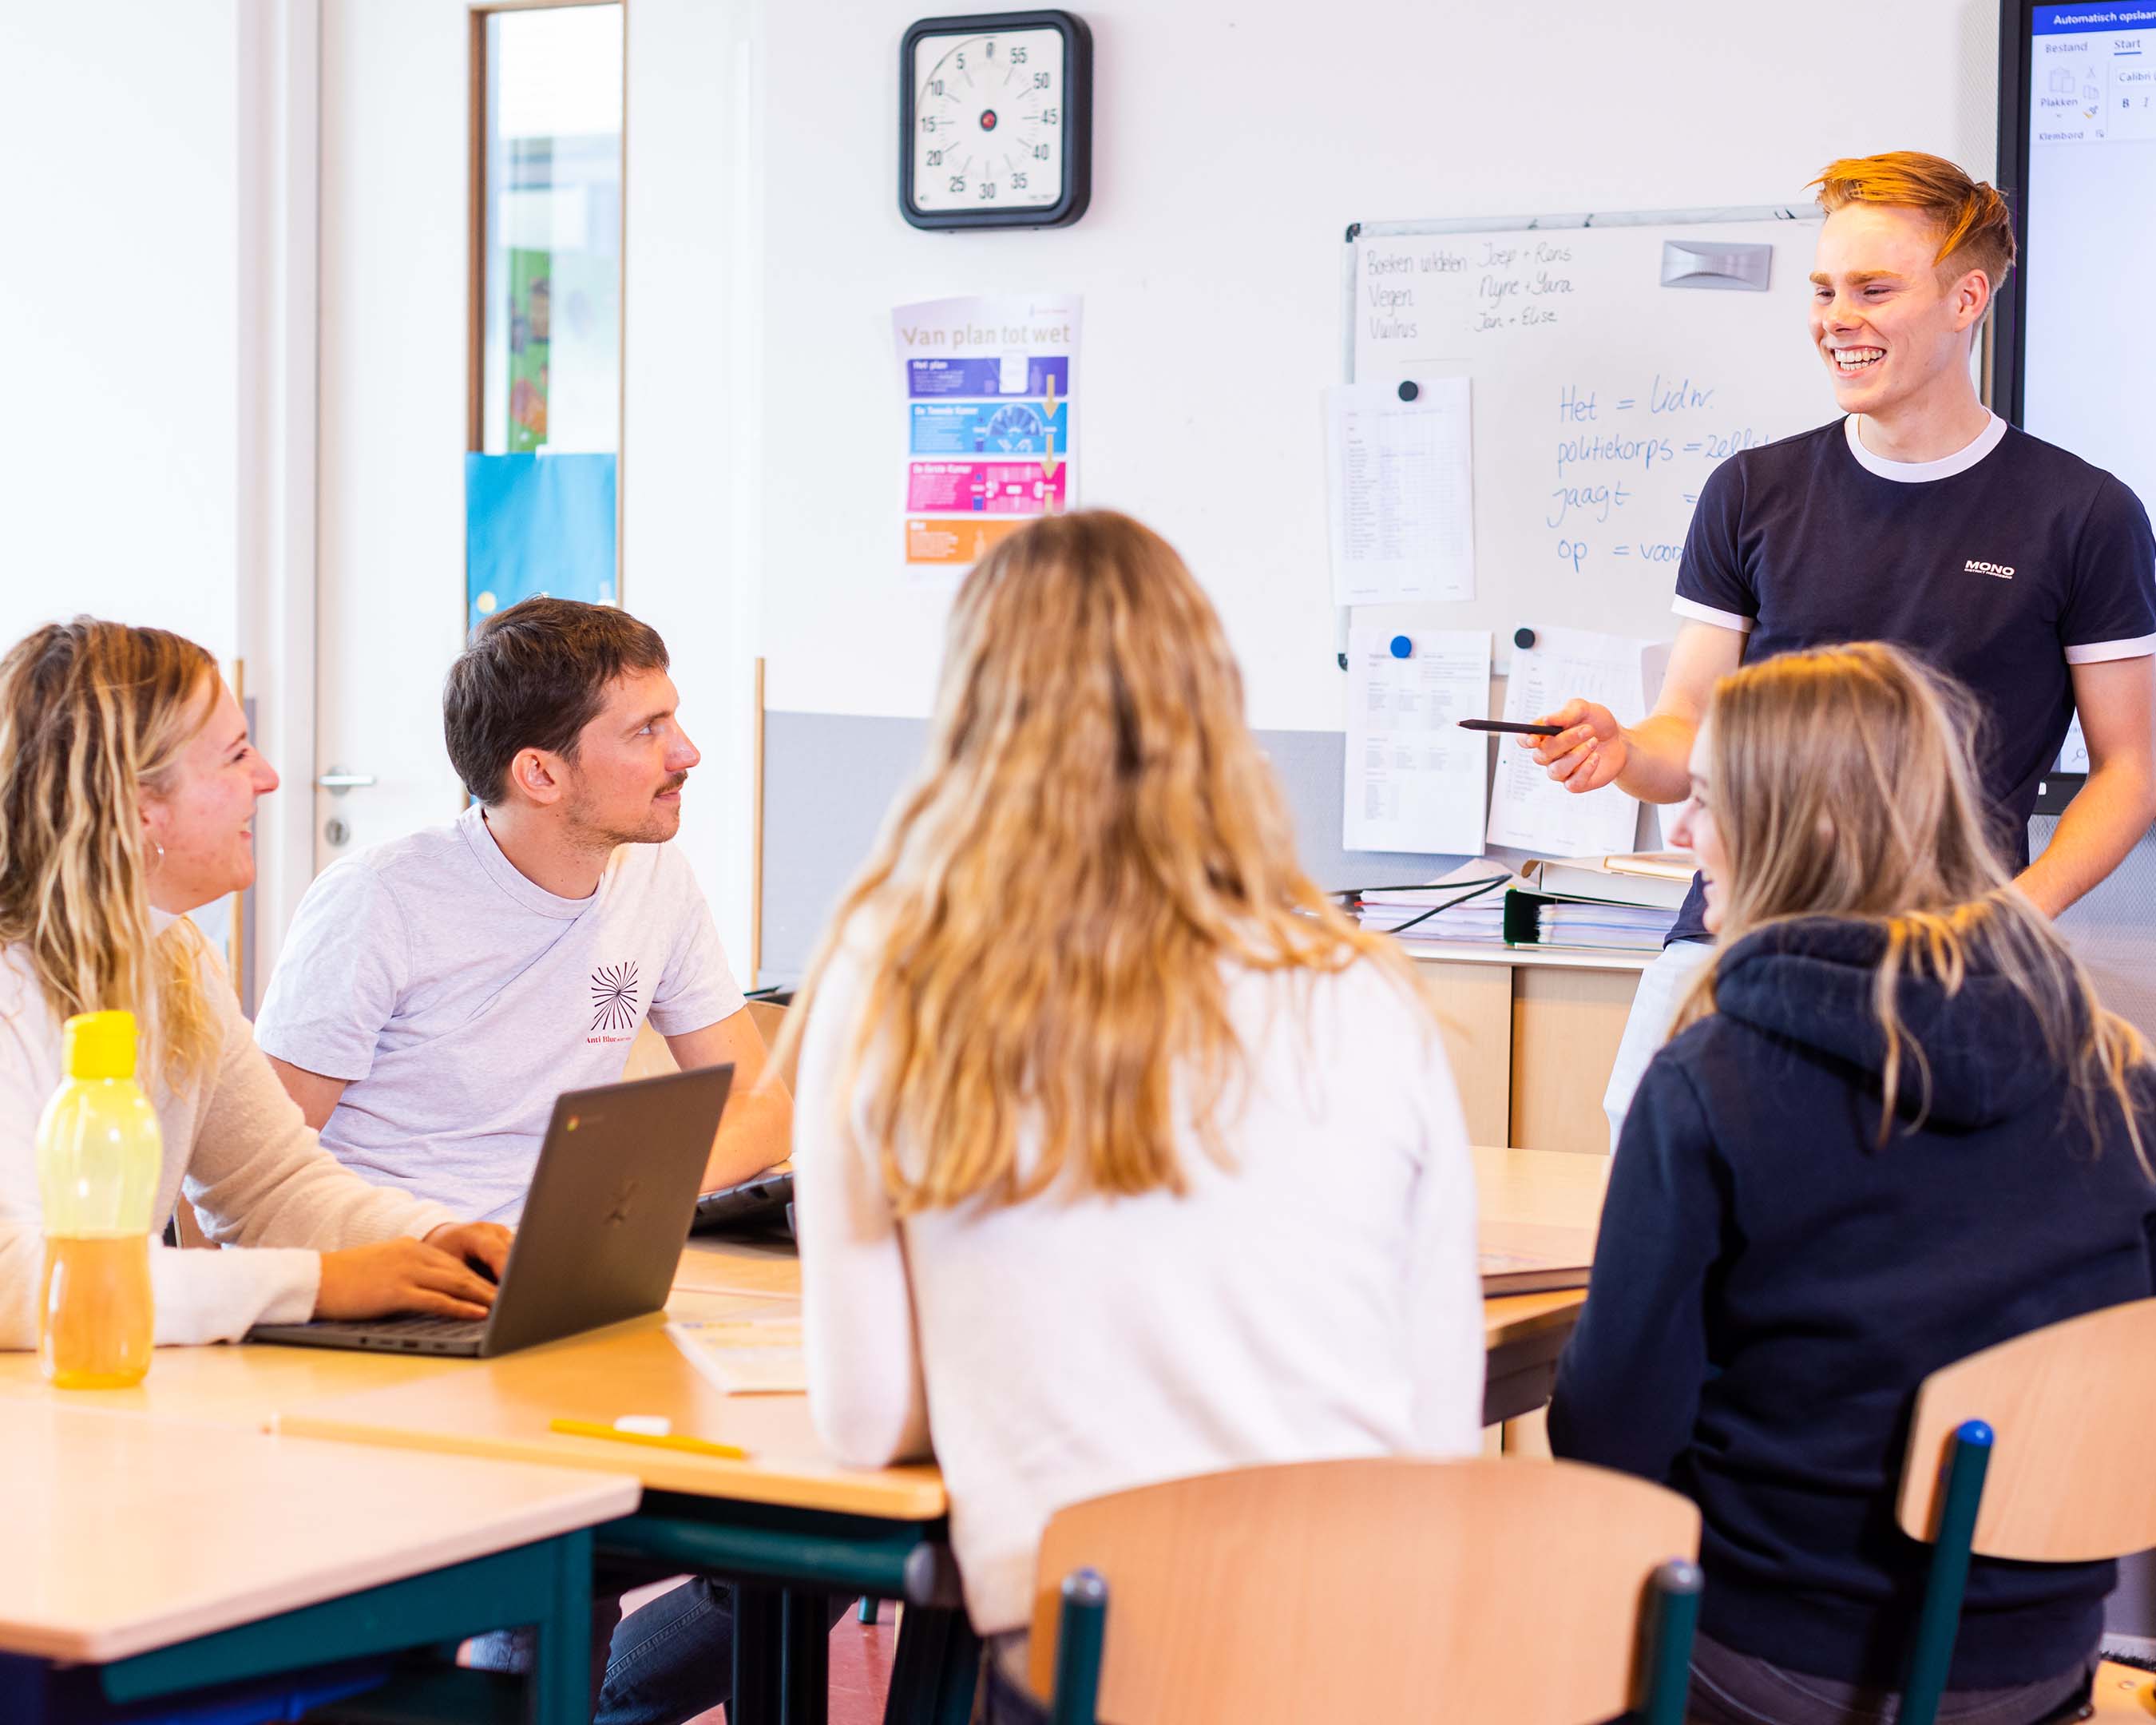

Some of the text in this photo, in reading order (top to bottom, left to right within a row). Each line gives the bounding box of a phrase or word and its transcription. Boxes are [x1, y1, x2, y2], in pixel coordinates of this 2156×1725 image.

[2053, 13, 2116, 26] Automatisch
[986, 42, 995, 58] 0
[2045, 39, 2141, 54] Bestand Start
[957, 54, 965, 69] 5
[1010, 47, 1028, 64] 55
[1033, 73, 1050, 89] 50
[2119, 73, 2151, 81] Calibri
[929, 80, 945, 96] 10
[2040, 97, 2078, 107] Plakken
[921, 116, 937, 133] 15
[1040, 109, 1058, 125] 45
[2039, 130, 2084, 141] Klembord
[926, 150, 943, 166] 20
[1032, 144, 1049, 161] 40
[949, 176, 965, 192] 25
[1011, 172, 1028, 189] 35
[979, 183, 995, 200] 30
[1367, 249, 1413, 276] Boeken
[1368, 283, 1415, 316] Vegen
[1474, 312, 1504, 332] Jan
[1521, 307, 1557, 326] Elise
[902, 323, 1071, 351] Van plan tot wet
[1560, 385, 1597, 422] Het
[1557, 434, 1674, 478] politiekorps
[1557, 540, 1587, 573] op
[1965, 561, 2015, 576] MONO
